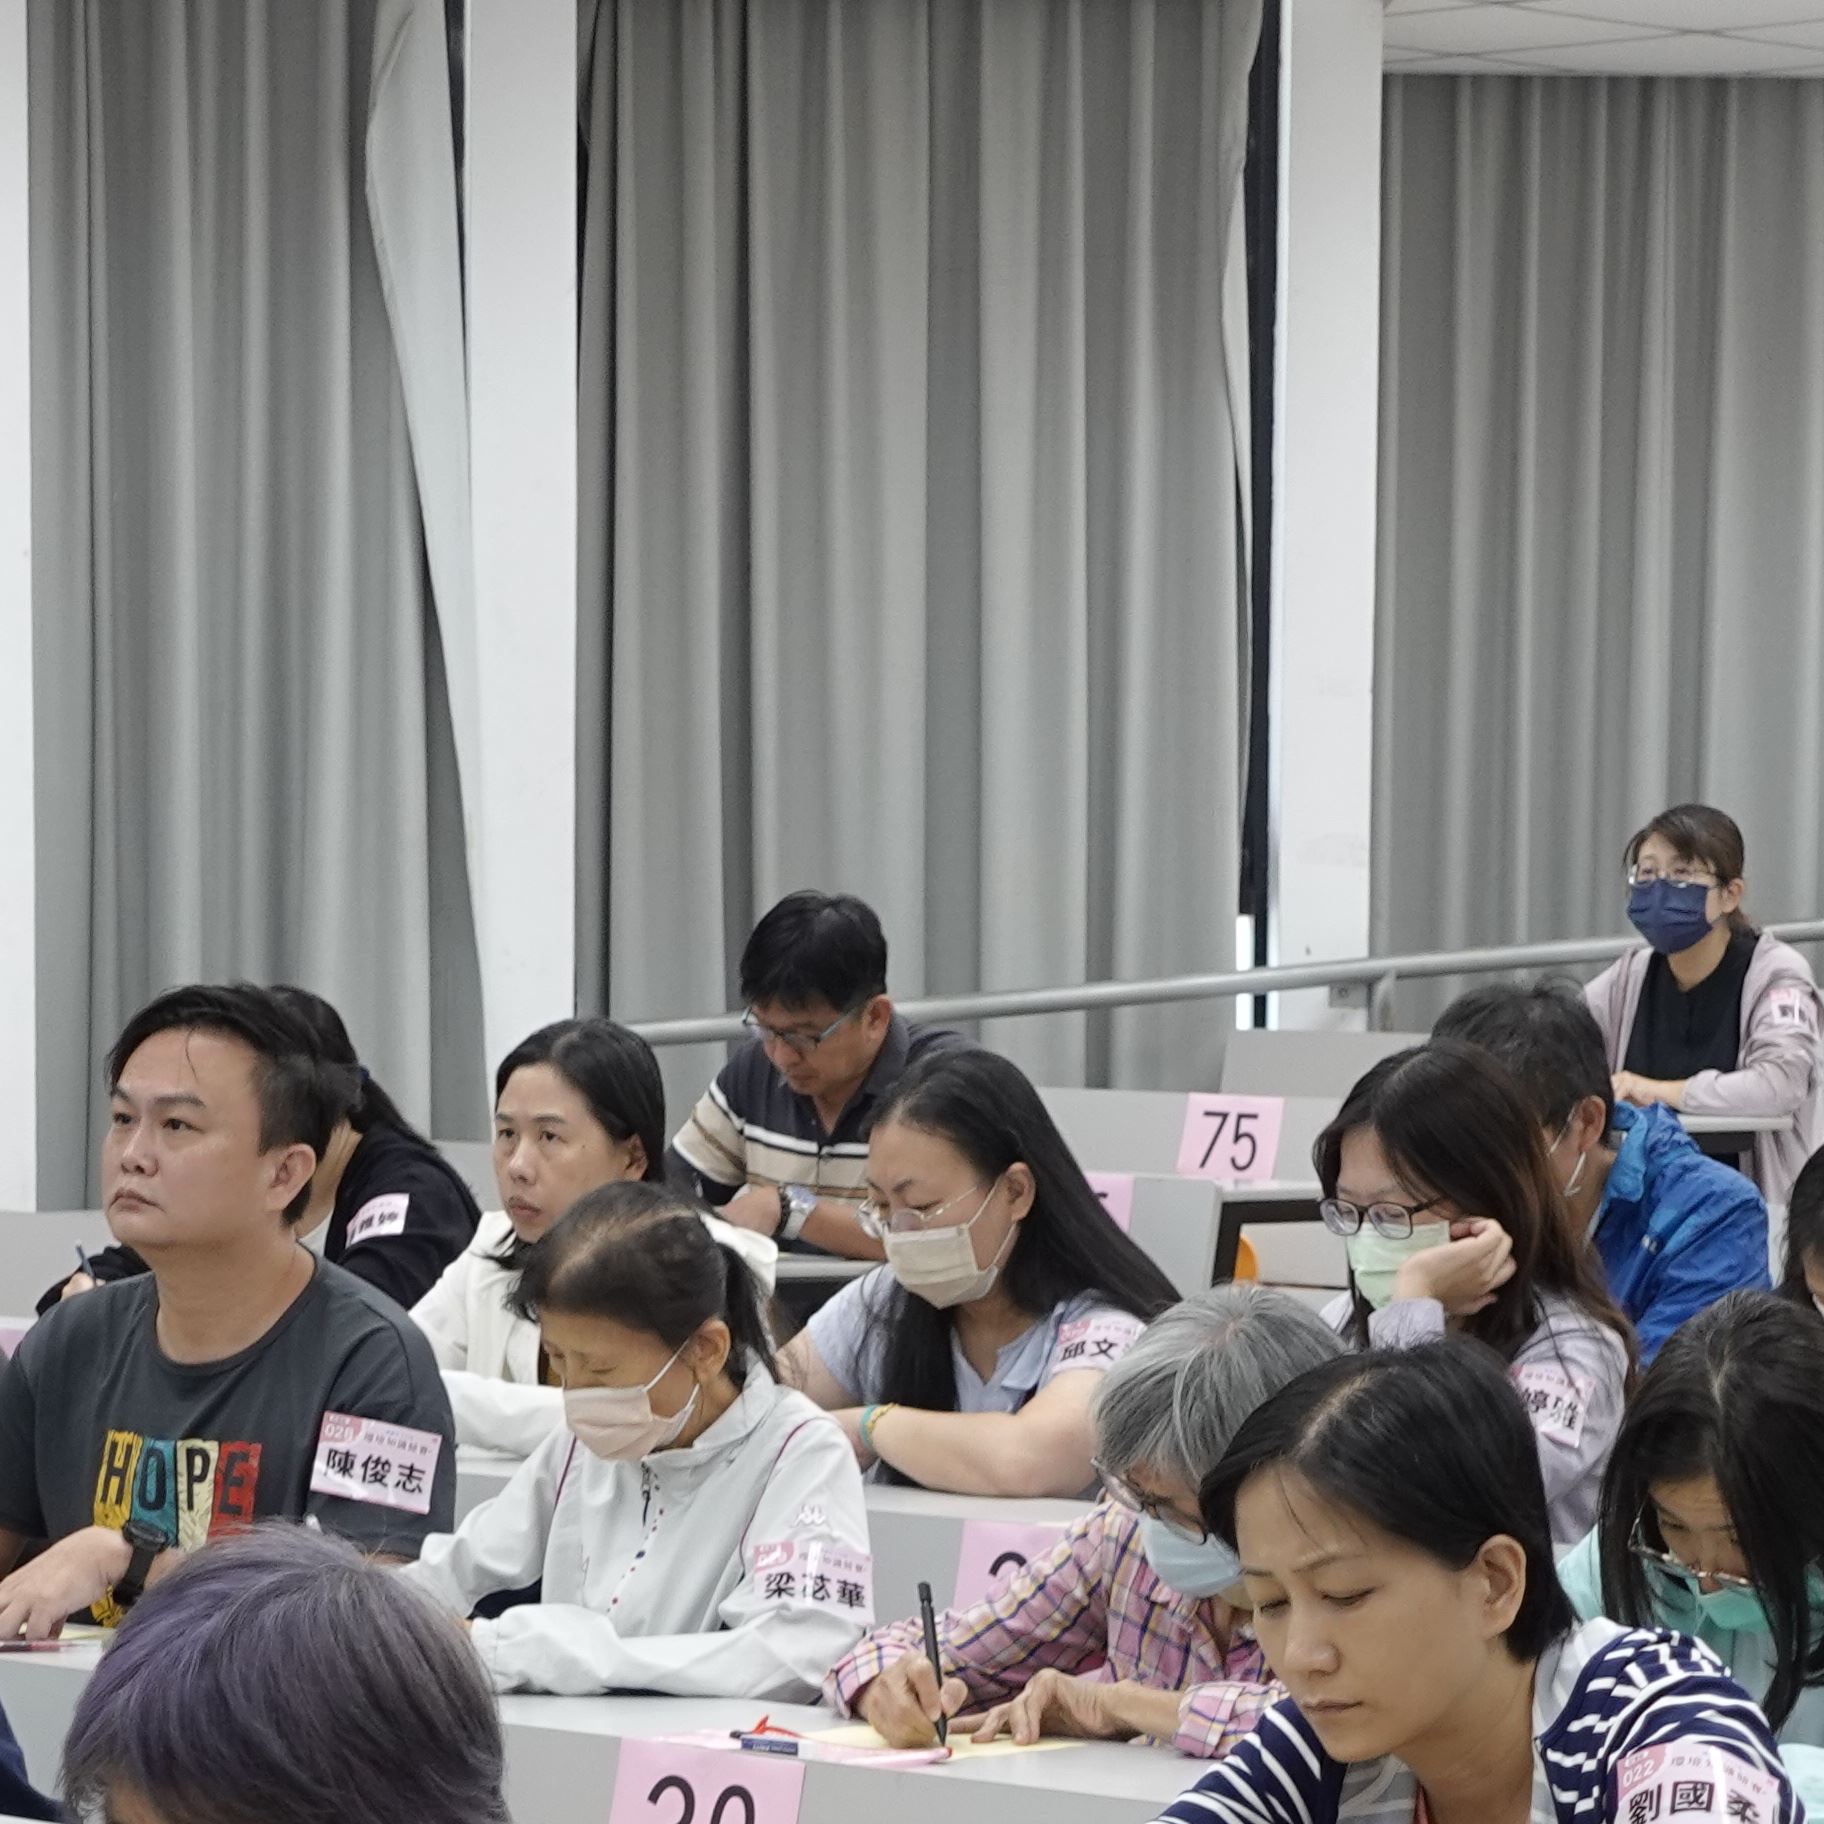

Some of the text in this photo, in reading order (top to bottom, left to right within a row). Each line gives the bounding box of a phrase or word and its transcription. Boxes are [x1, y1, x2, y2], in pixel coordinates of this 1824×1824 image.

[1199, 1110, 1259, 1172] 75
[99, 1434, 250, 1517] HOPE
[323, 1448, 426, 1494] 陳俊志
[1622, 1759, 1655, 1788] 022
